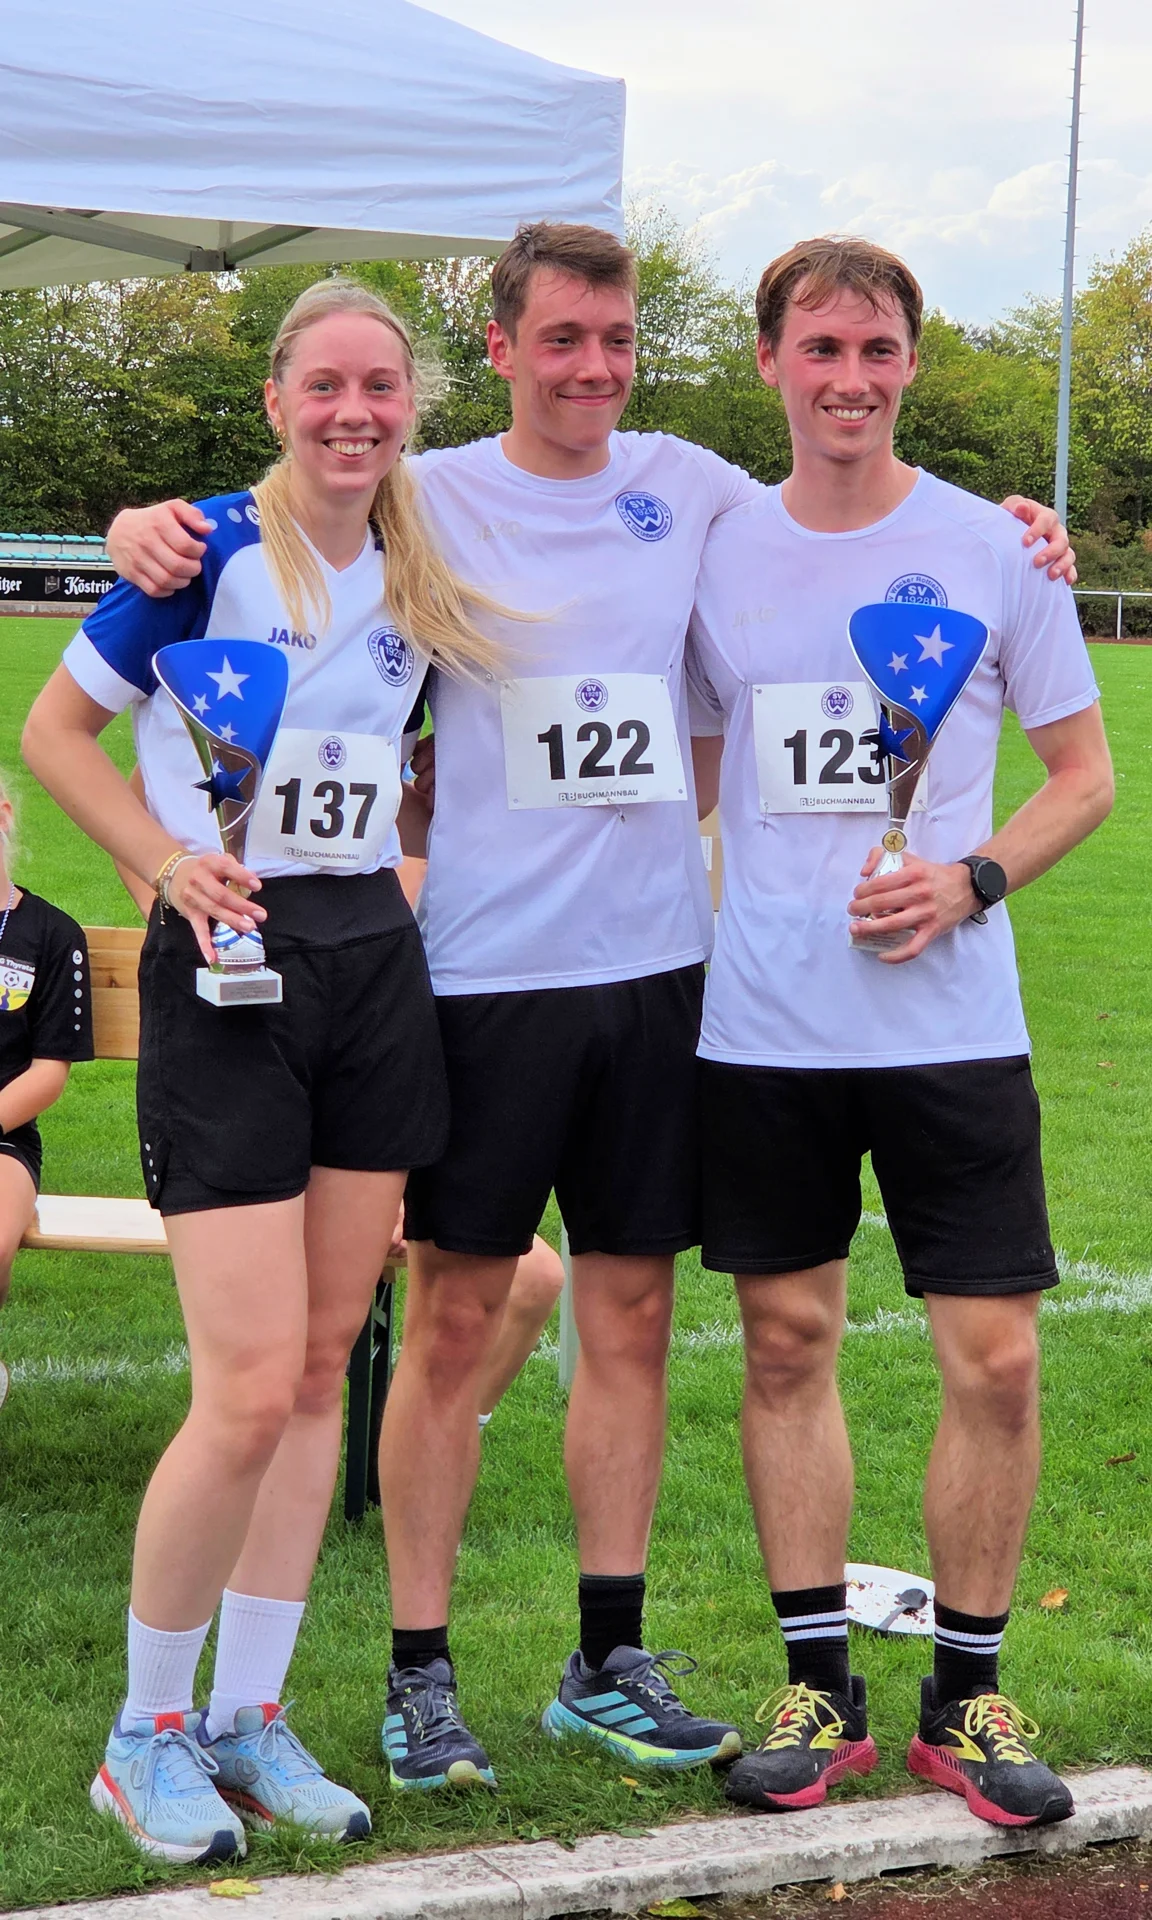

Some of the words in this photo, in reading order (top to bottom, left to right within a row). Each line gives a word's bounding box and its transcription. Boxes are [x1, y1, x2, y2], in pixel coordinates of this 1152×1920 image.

[629, 500, 646, 509] SV
[632, 506, 656, 516] 1928
[907, 585, 928, 596] SV
[904, 596, 930, 605] 1928
[267, 627, 317, 650] JAKO
[385, 636, 401, 648] SV
[537, 719, 654, 780] 122
[784, 729, 888, 786] 123
[577, 789, 639, 800] BUCHMANNBAU
[816, 797, 876, 805] BUCHMANNBAU
[275, 778, 378, 840] 137
[303, 850, 360, 860] BUCHMANNBAU
